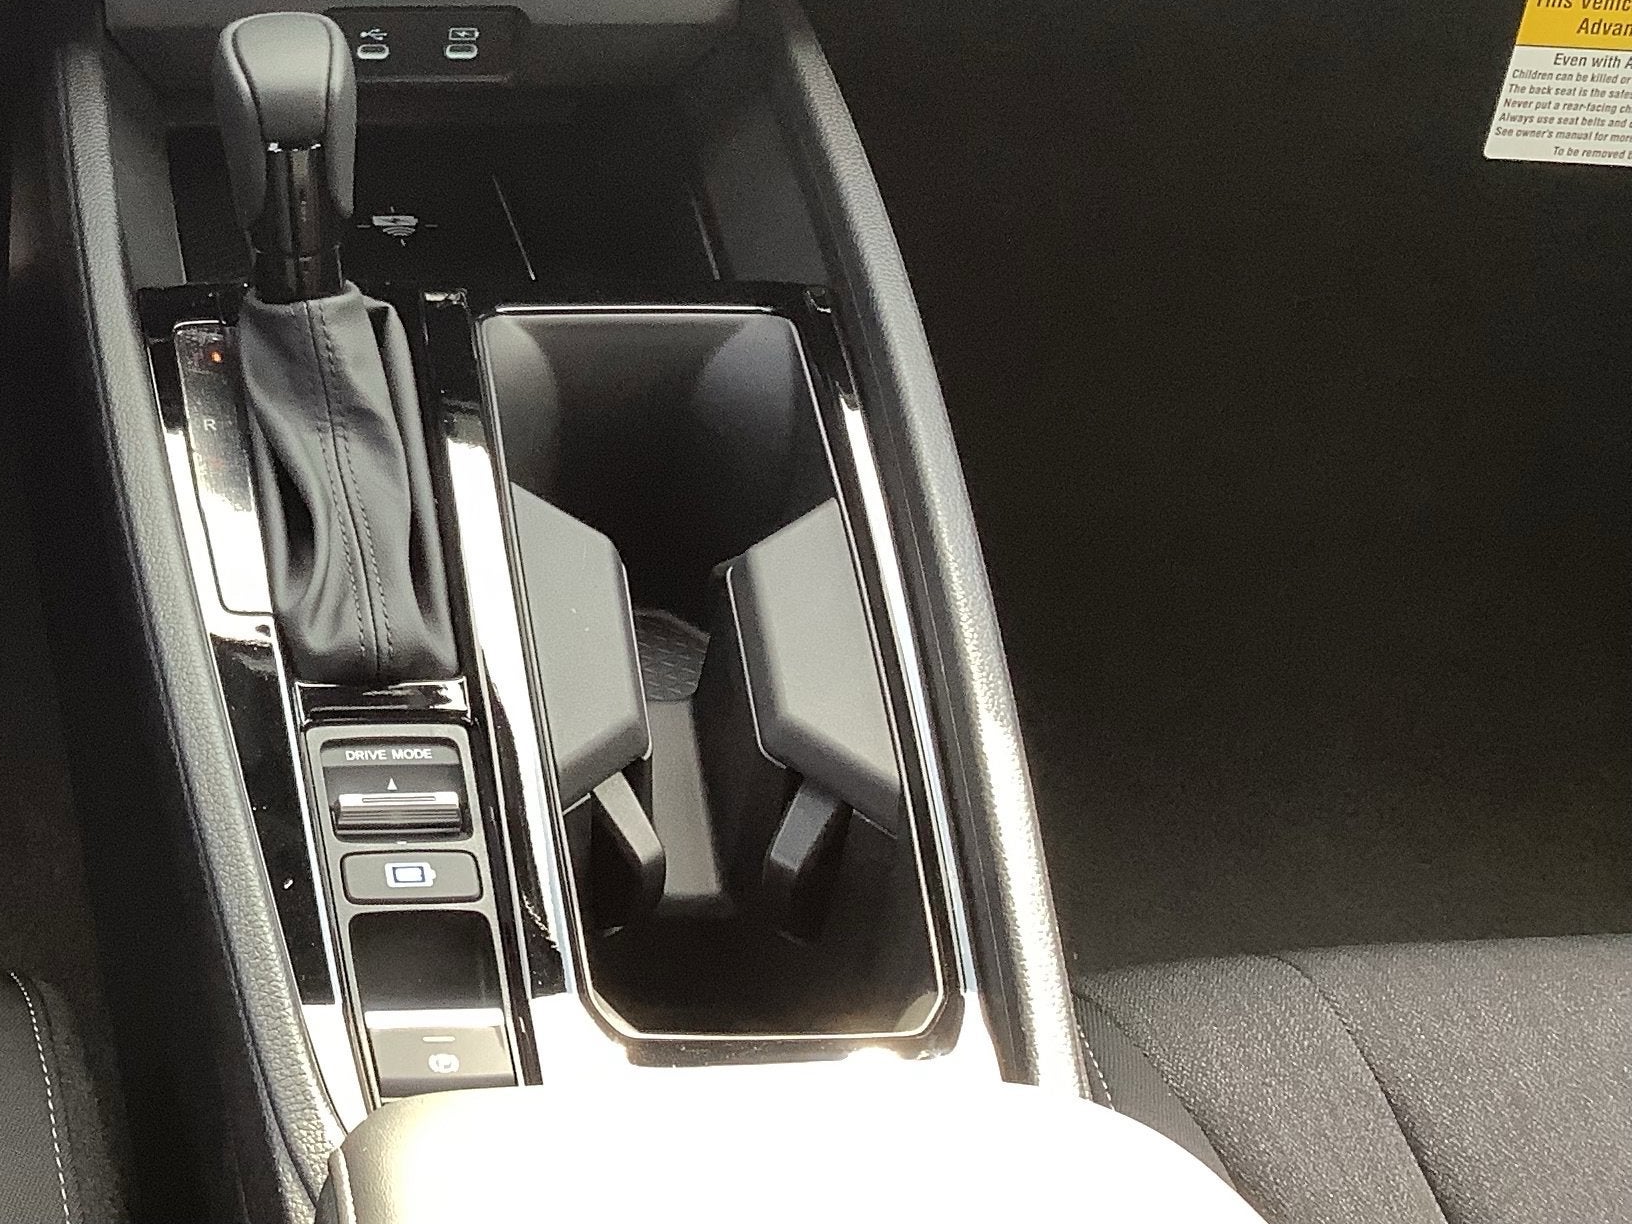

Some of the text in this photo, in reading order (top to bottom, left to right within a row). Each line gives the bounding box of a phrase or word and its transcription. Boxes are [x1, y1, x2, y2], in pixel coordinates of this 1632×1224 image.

[1554, 52, 1587, 67] Even
[1591, 54, 1621, 68] with
[1512, 69, 1632, 84] Children can be killed or
[1509, 83, 1526, 94] The
[1529, 84, 1552, 95] back
[1554, 87, 1576, 96] seat
[1578, 87, 1588, 96] is
[1590, 88, 1607, 98] the
[1503, 98, 1533, 108] Never
[1535, 100, 1552, 110] put
[1553, 102, 1560, 110] a
[1562, 102, 1618, 115] rear-facing
[1499, 112, 1534, 125] Always
[1536, 116, 1555, 124] use
[1557, 116, 1579, 125] seat
[1581, 116, 1606, 126] belts
[1608, 119, 1627, 128] and
[1495, 126, 1513, 136] See
[1516, 128, 1553, 138] owner's
[1555, 131, 1593, 141] manual
[1594, 131, 1608, 141] for
[1554, 146, 1564, 156] To
[1567, 147, 1579, 156] be
[1582, 149, 1626, 159] removed
[204, 419, 217, 431] R
[345, 747, 433, 762] DRIVE MODE
